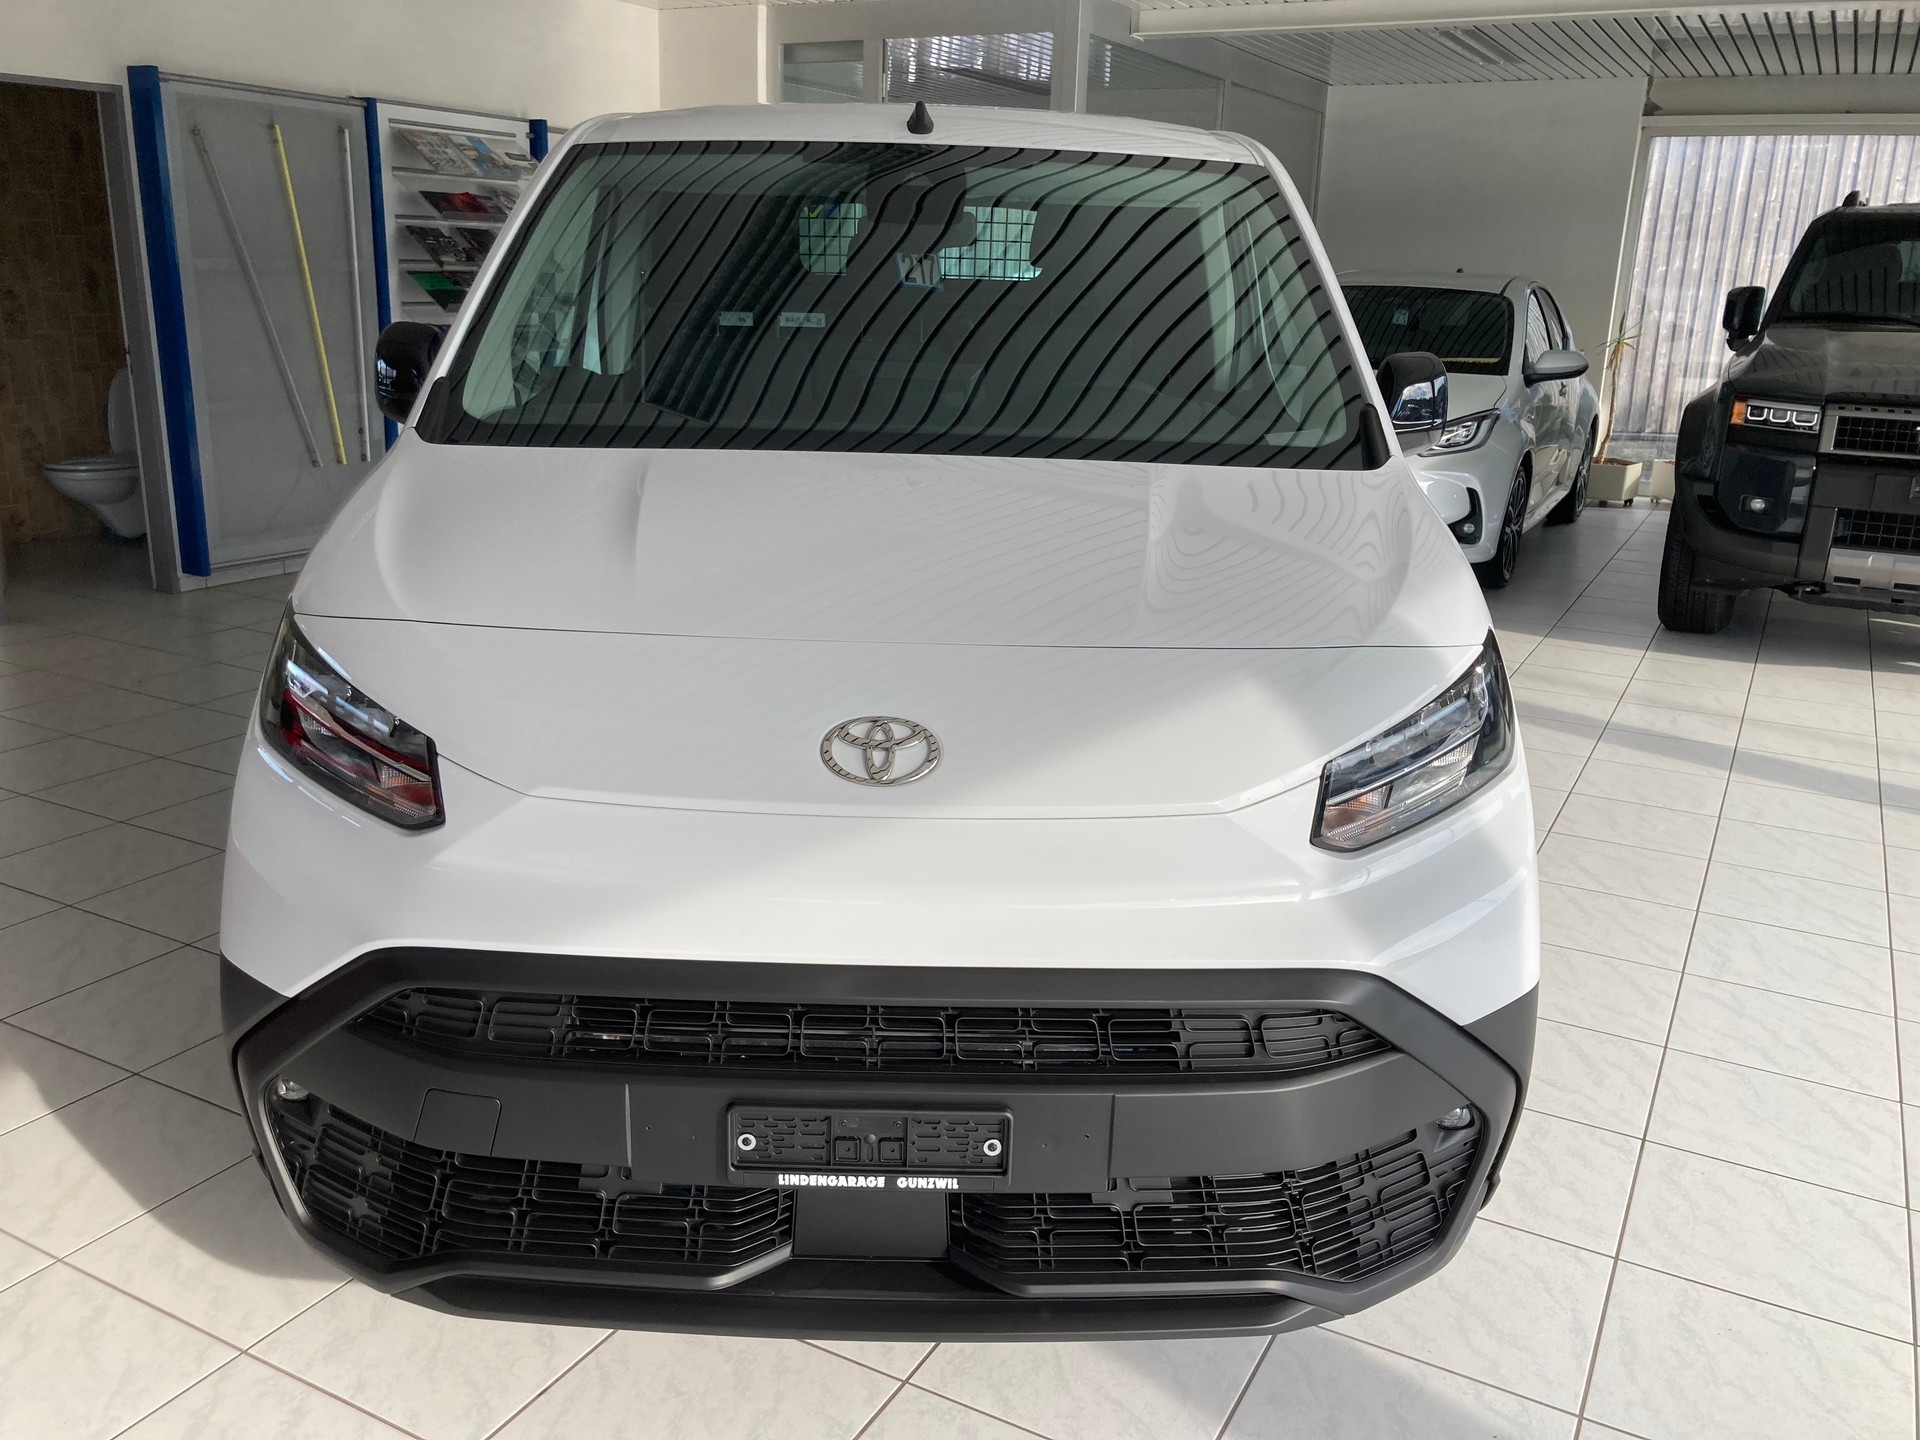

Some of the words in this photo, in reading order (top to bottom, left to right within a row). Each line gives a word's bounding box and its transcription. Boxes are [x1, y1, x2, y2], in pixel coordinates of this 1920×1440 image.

[901, 252, 935, 286] 217
[778, 1174, 886, 1188] LINDENGARAGE
[897, 1176, 959, 1189] GUNZWIL
